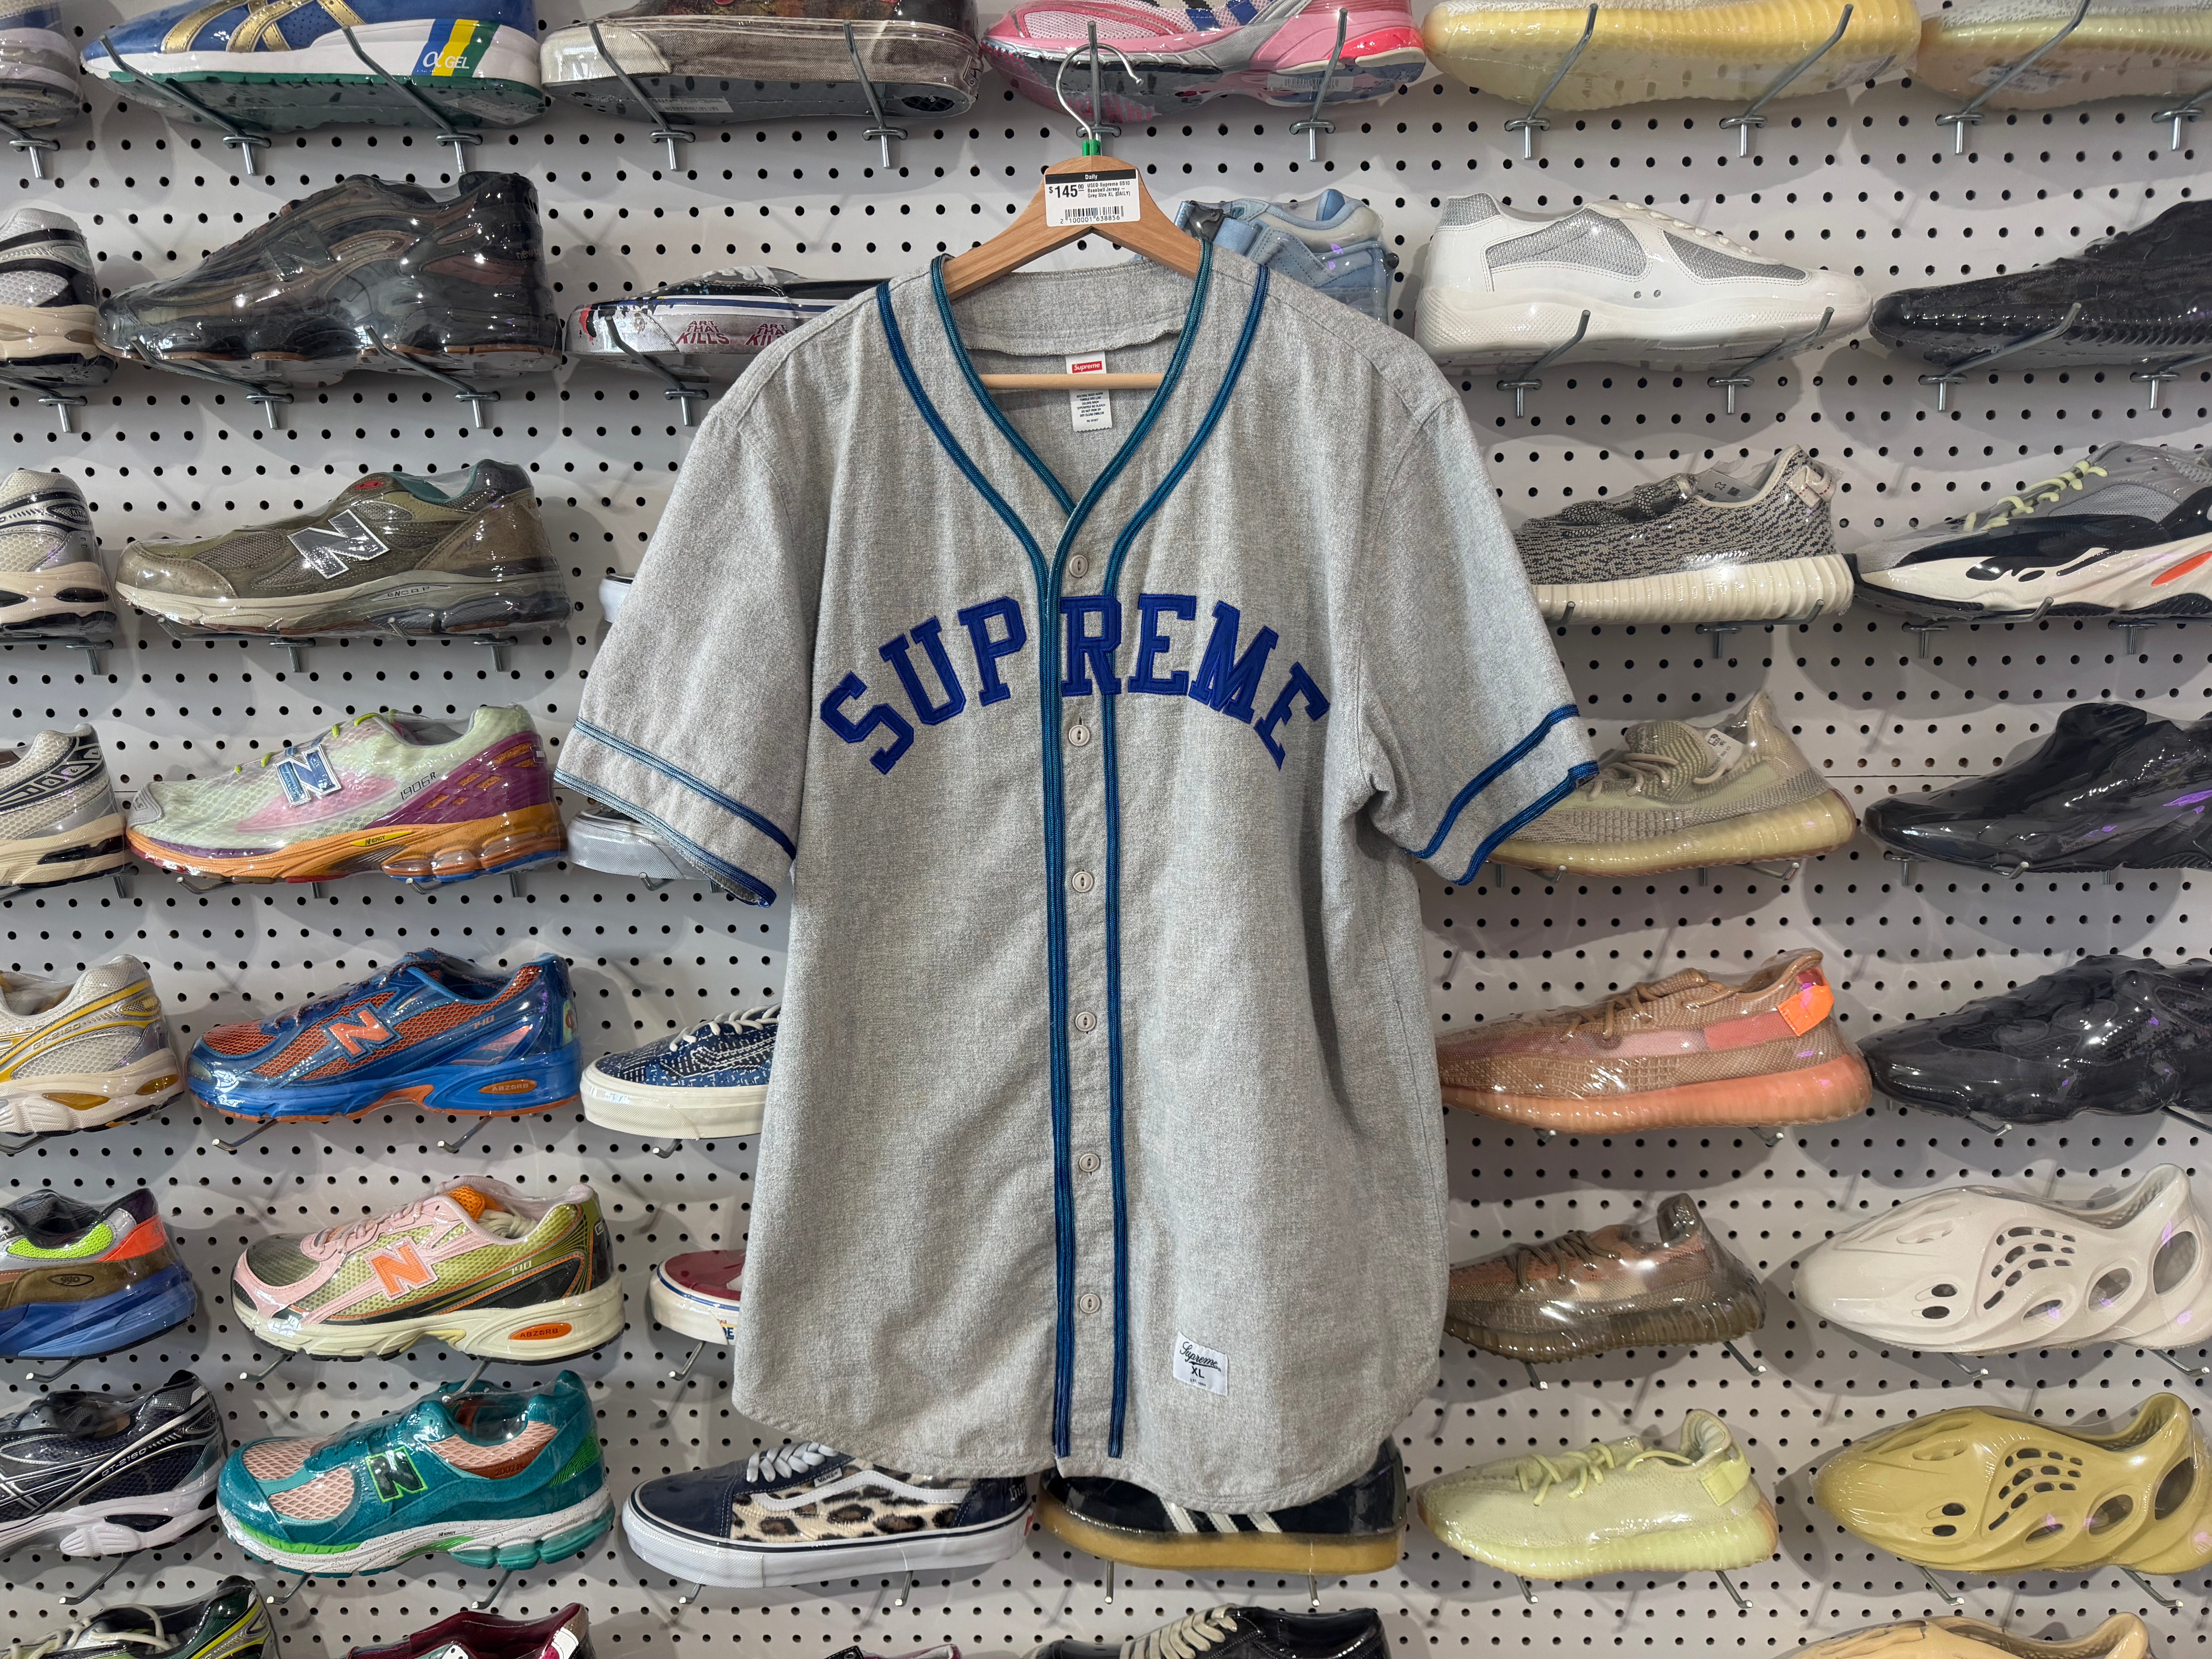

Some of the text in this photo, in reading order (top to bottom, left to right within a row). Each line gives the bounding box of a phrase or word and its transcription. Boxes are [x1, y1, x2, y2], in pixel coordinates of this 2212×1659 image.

[445, 55, 470, 69] GEL
[675, 332, 730, 345] KILLS
[1073, 362, 1101, 372] Supreme
[820, 593, 1331, 776] SUPREME
[400, 772, 436, 800] 1906R
[469, 1015, 495, 1030] 740
[33, 1022, 81, 1049] GT-2160
[507, 1260, 532, 1275] 740
[61, 1276, 81, 1285] 990
[1180, 1341, 1218, 1369] Supreme
[1191, 1366, 1205, 1379] XL
[101, 1447, 147, 1477] GT-2160
[817, 1473, 834, 1482] VANS
